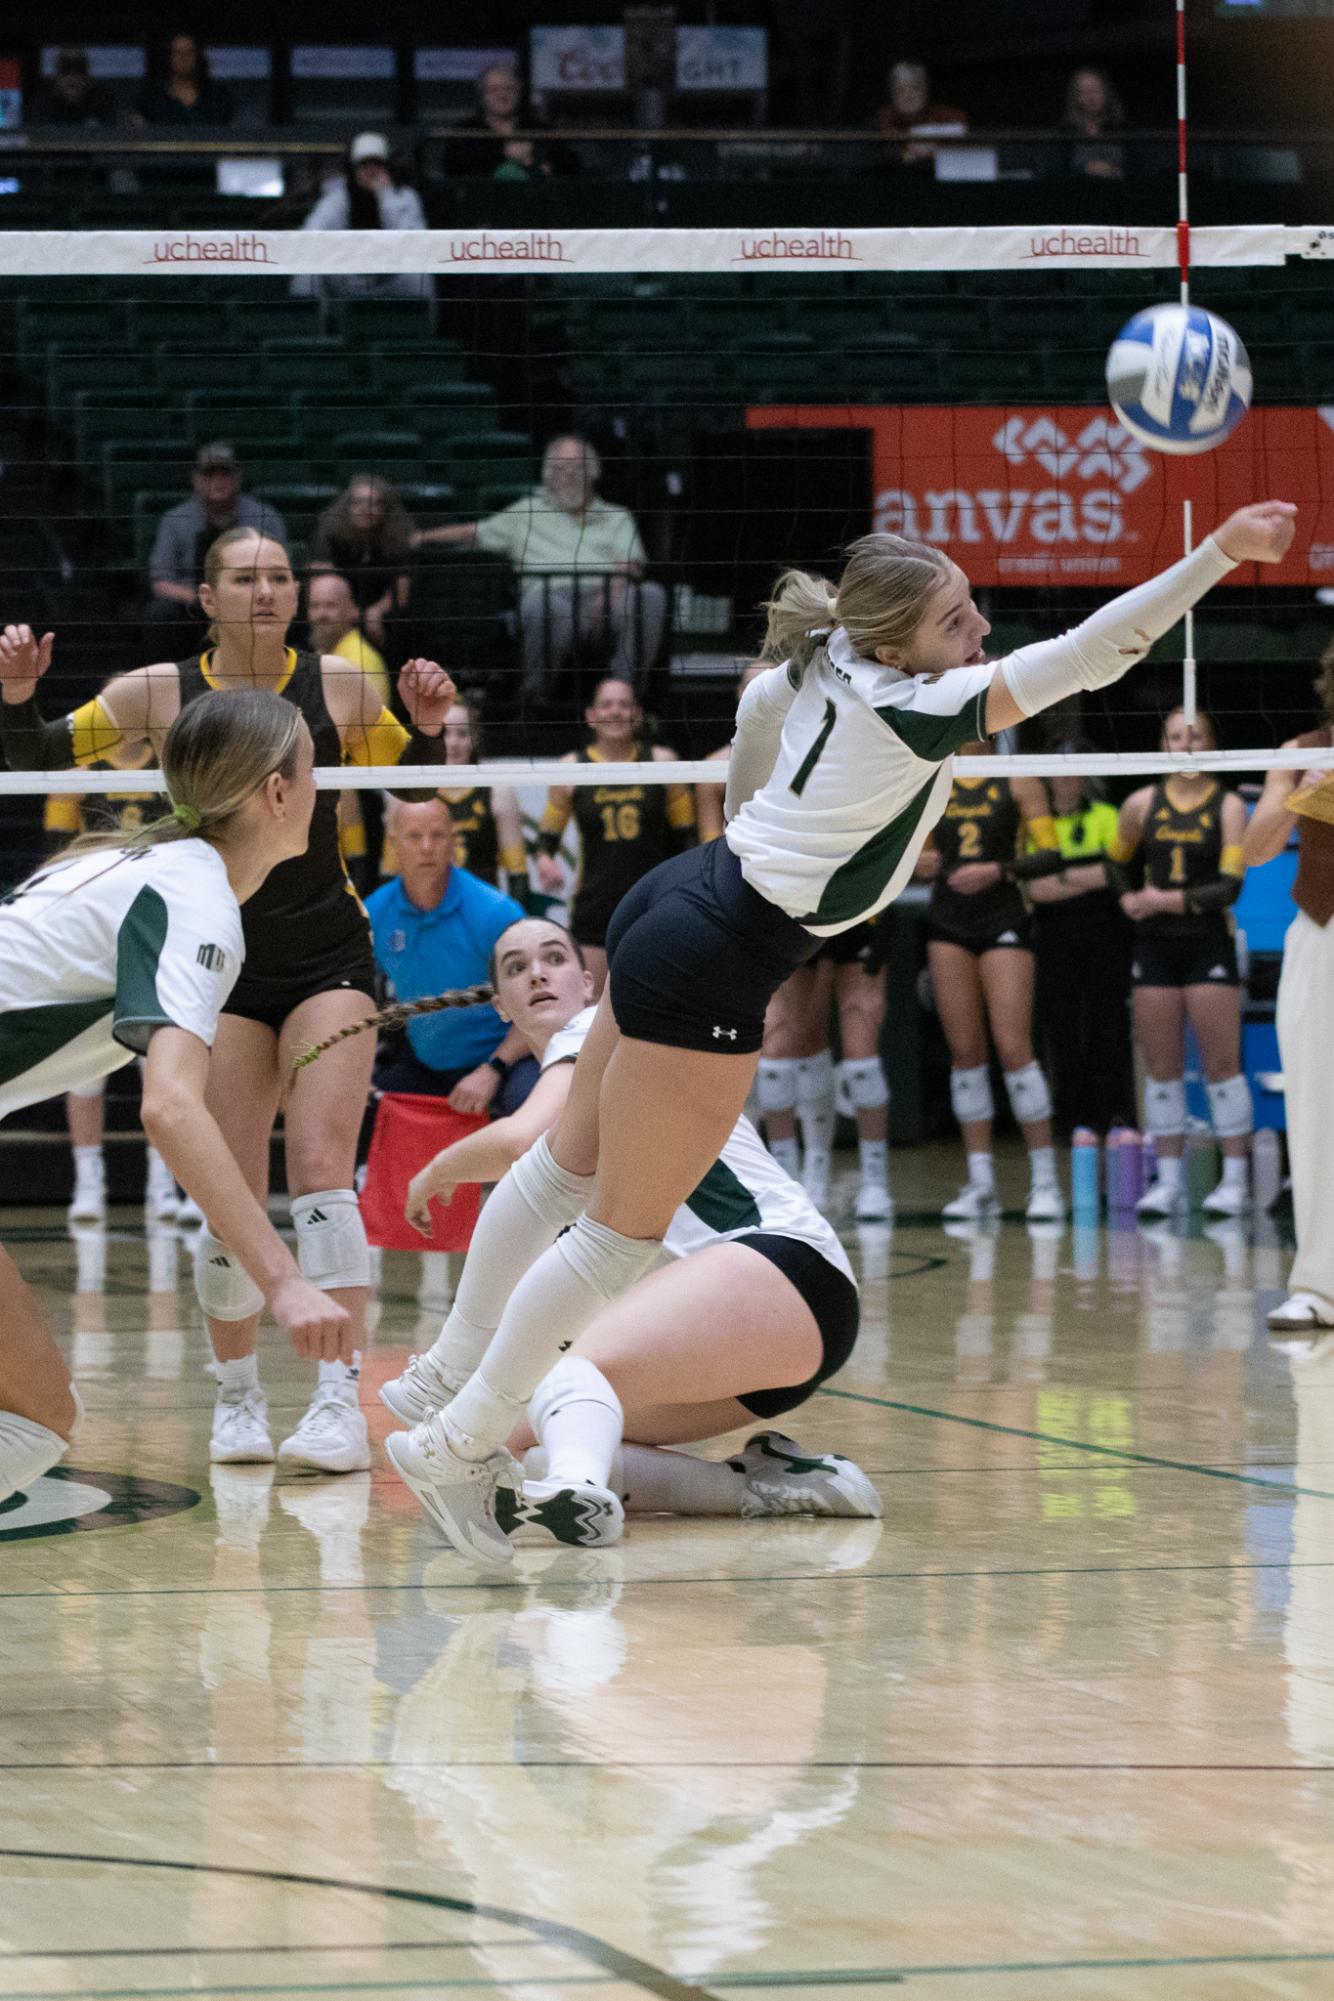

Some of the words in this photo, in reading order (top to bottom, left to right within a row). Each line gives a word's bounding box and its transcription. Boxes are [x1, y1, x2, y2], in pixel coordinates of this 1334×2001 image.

[153, 233, 268, 261] uchealth
[450, 232, 562, 260] uchealth
[741, 231, 854, 258] uchealth
[1030, 229, 1141, 256] uchealth
[872, 488, 1124, 544] anvas
[788, 695, 837, 800] 1
[957, 821, 982, 858] 2
[1168, 846, 1185, 883] 1
